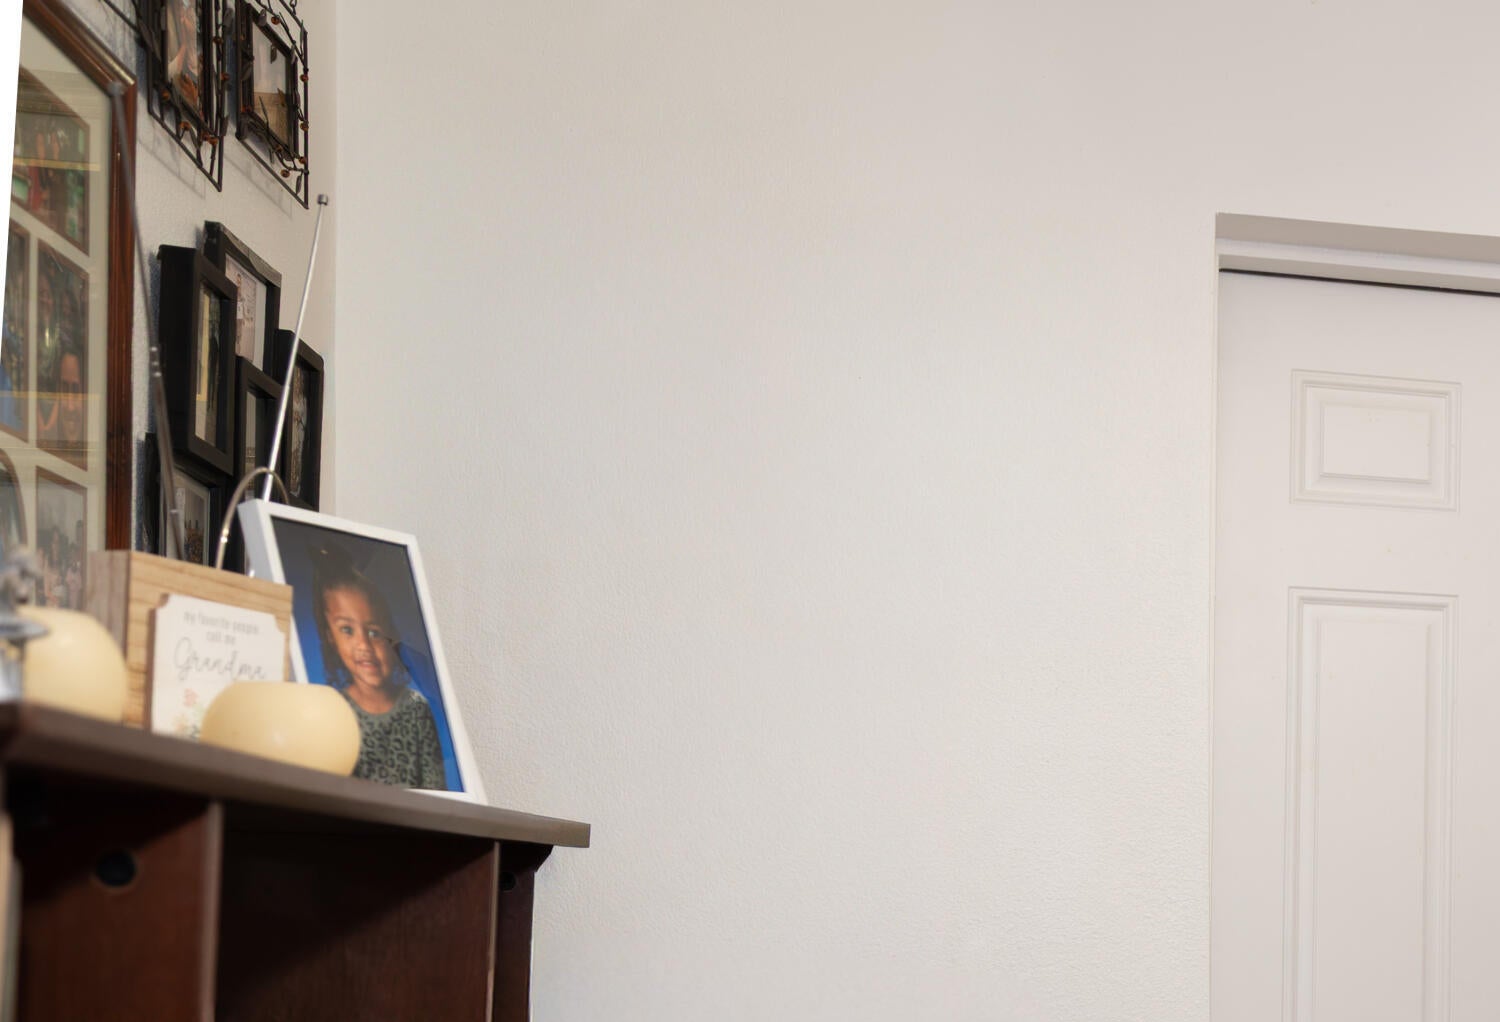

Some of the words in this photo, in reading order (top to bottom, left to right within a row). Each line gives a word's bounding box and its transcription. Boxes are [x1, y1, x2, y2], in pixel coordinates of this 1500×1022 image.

[198, 612, 231, 630] favorite
[232, 621, 259, 635] people
[174, 637, 268, 682] Grandma
